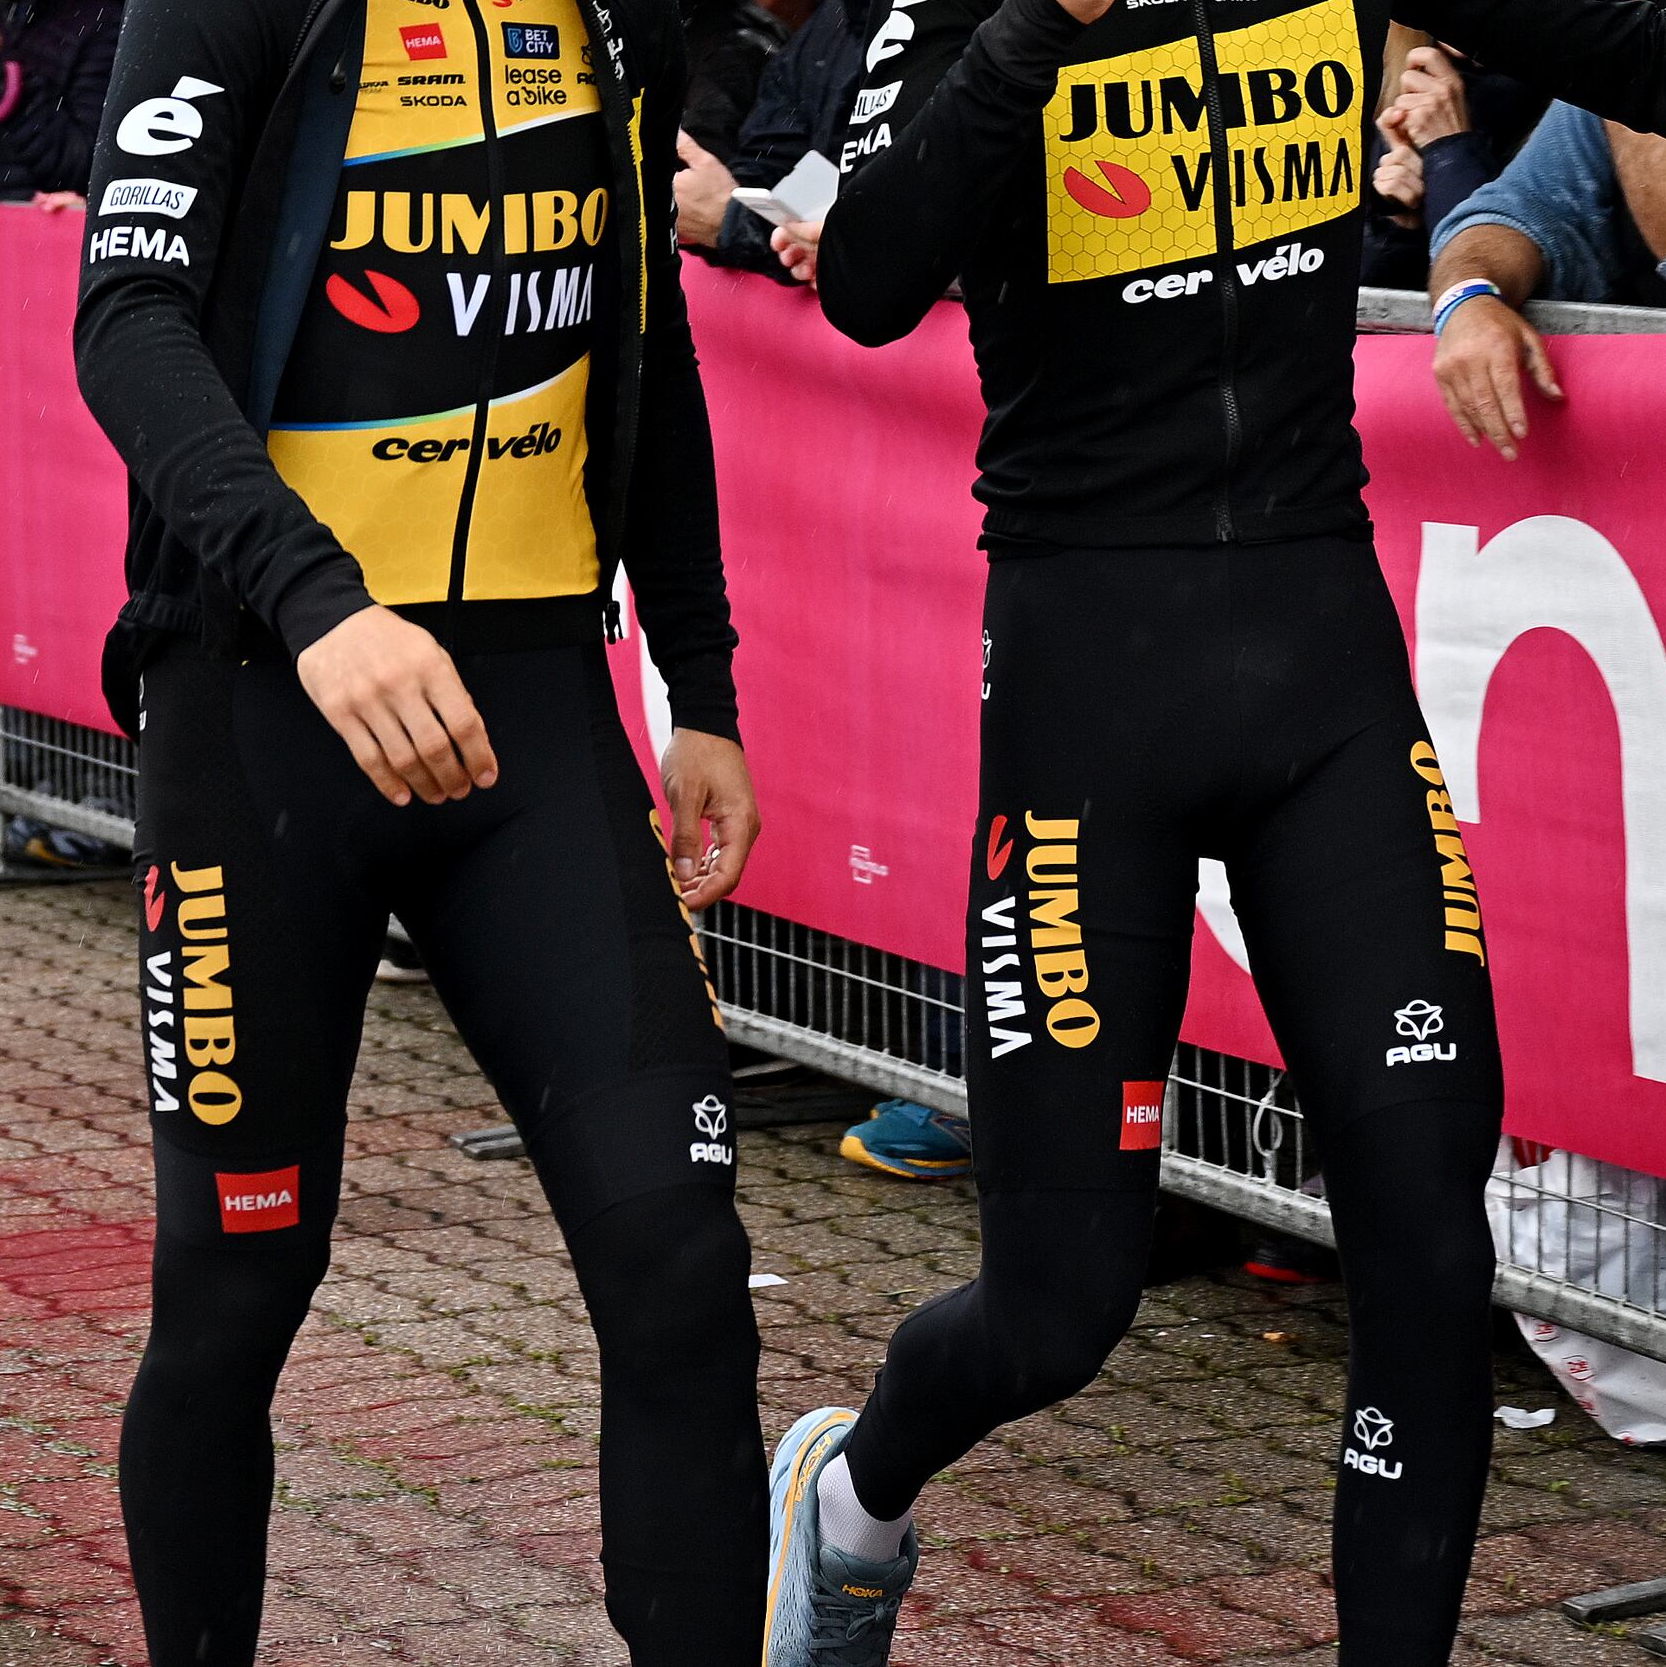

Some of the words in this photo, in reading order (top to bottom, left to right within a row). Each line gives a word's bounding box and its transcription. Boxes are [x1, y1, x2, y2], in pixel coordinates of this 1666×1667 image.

[405, 35, 442, 49] HEMA
[525, 29, 548, 42] BET
[526, 41, 554, 54] CITY
[397, 73, 466, 86] SRAM
[505, 64, 562, 84] lease
[116, 75, 226, 156] é
[400, 95, 468, 107] SKODA
[1059, 59, 1354, 143] JUMBO
[840, 123, 892, 174] EMA
[1171, 138, 1354, 212] VISMA
[109, 185, 184, 210] GORILLAS
[330, 187, 609, 255] JUMBO
[89, 226, 190, 267] HEMA
[446, 263, 594, 337] VISMA
[1410, 740, 1485, 967] JUMBO
[1025, 810, 1101, 1049] JUMBO
[171, 861, 243, 1126] JUMBO
[981, 896, 1033, 1059] VISMA
[147, 950, 180, 1112] VISMA
[1386, 1042, 1457, 1067] AGU
[1126, 1105, 1160, 1124] HEMA
[690, 1142, 733, 1165] AGU
[225, 1189, 293, 1211] HEMA
[794, 1434, 832, 1502] HOKA
[1344, 1447, 1403, 1480] AGU
[841, 1584, 884, 1598] HOKA
